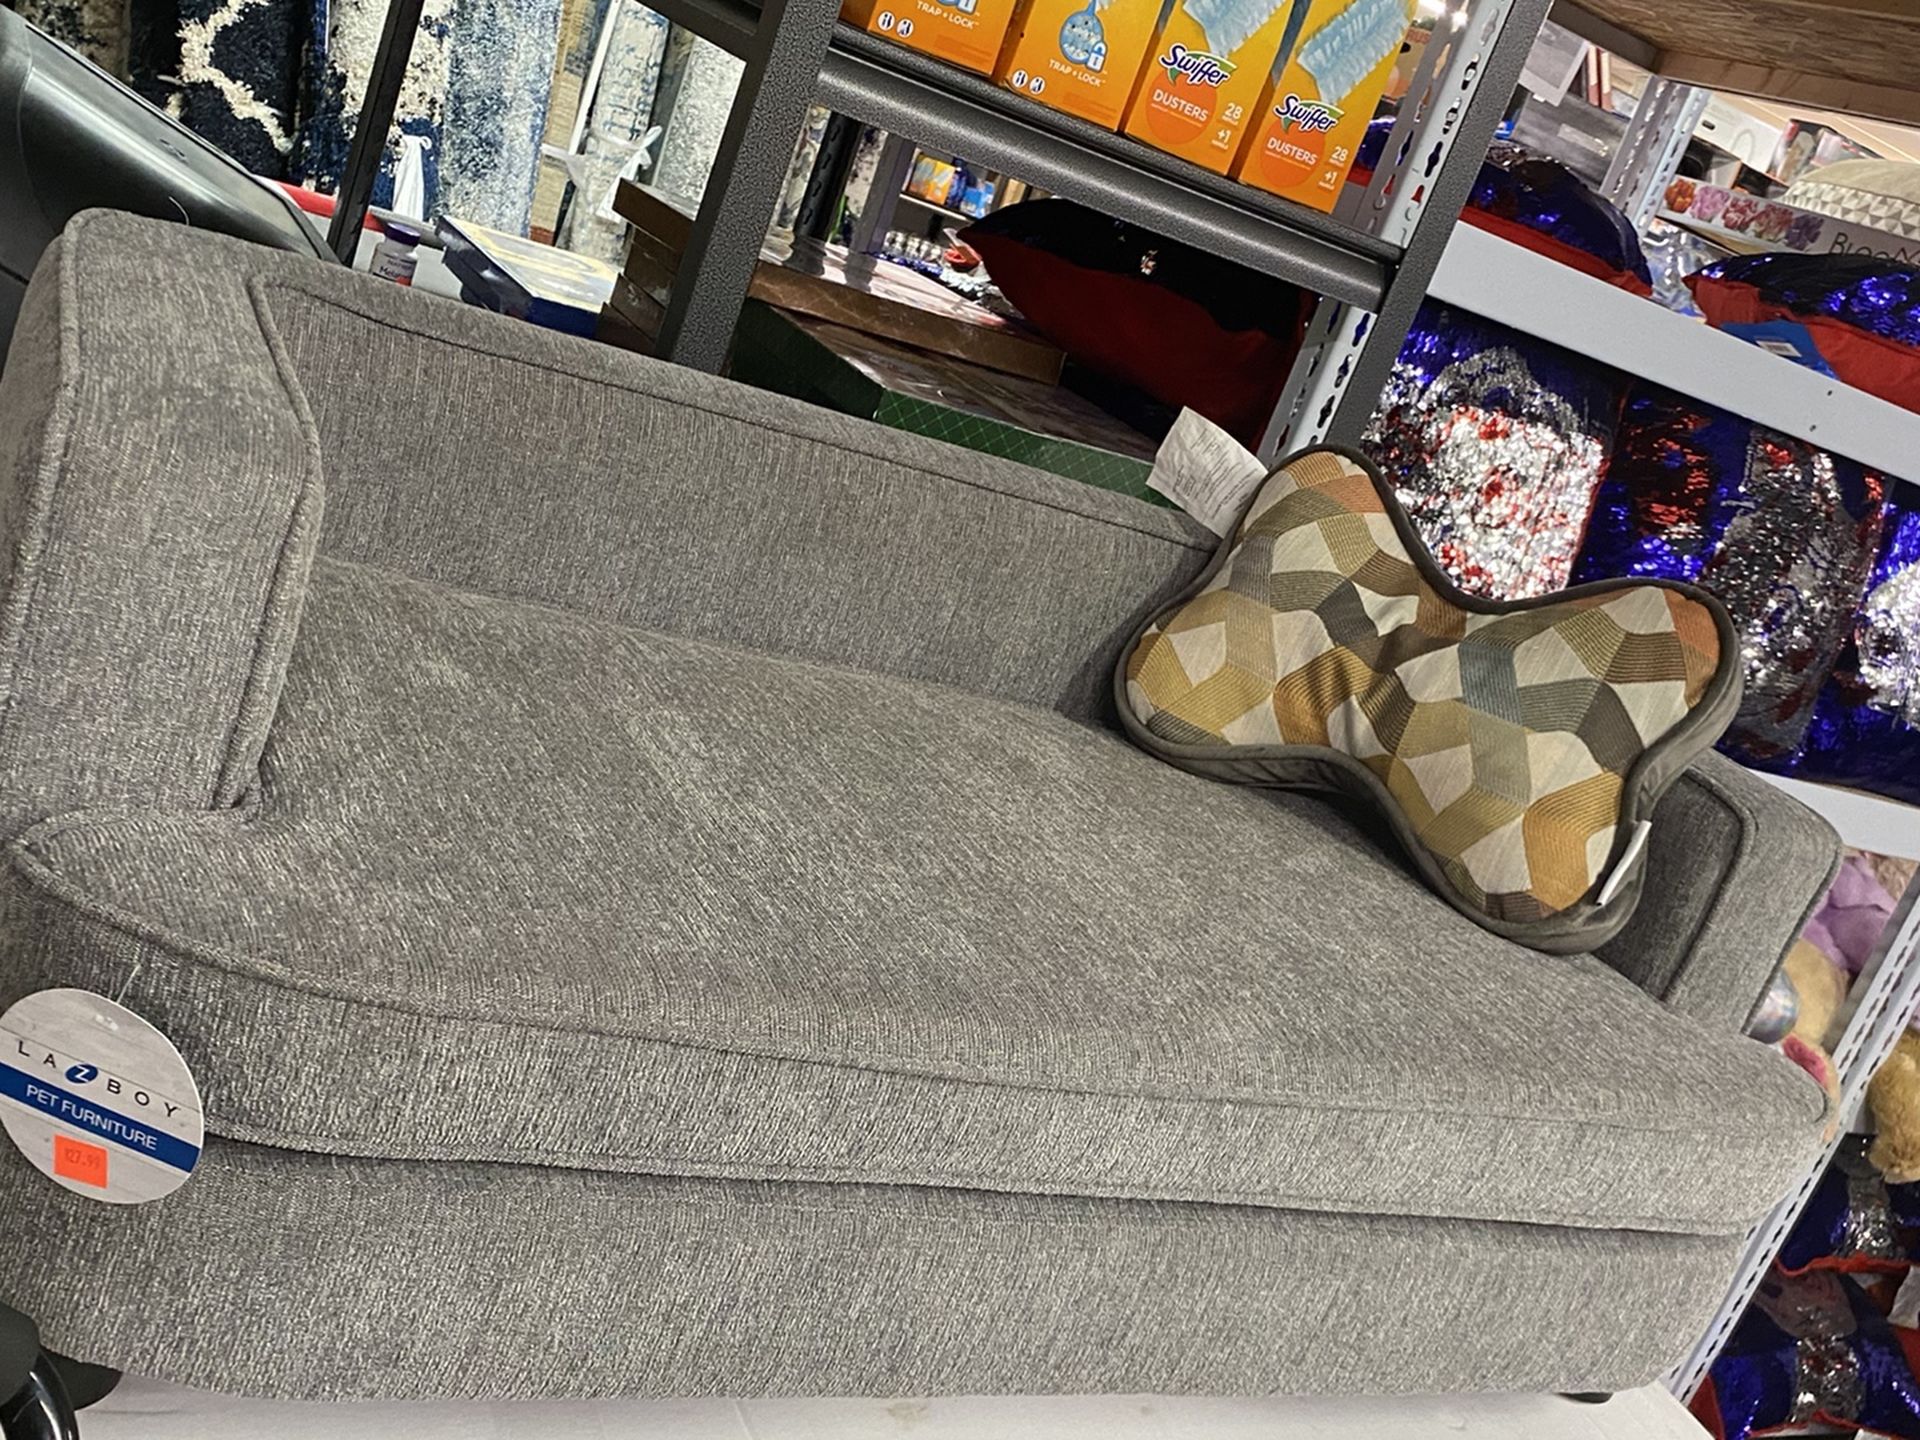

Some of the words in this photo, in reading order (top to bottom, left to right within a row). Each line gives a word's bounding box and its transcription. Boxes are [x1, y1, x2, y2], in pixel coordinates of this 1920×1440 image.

[916, 1, 943, 16] TRAP
[948, 14, 976, 29] LOCK
[1048, 59, 1072, 75] TRAP
[1077, 71, 1102, 87] LOCK
[1159, 44, 1230, 86] Swiffer
[1152, 88, 1209, 122] DUSTERS
[1224, 102, 1243, 120] 28
[1274, 94, 1338, 132] Swiffer
[1266, 137, 1318, 166] DUSTERS
[1331, 146, 1349, 162] 28
[26, 1084, 57, 1108] PET
[61, 1100, 159, 1151] FURNITURE
